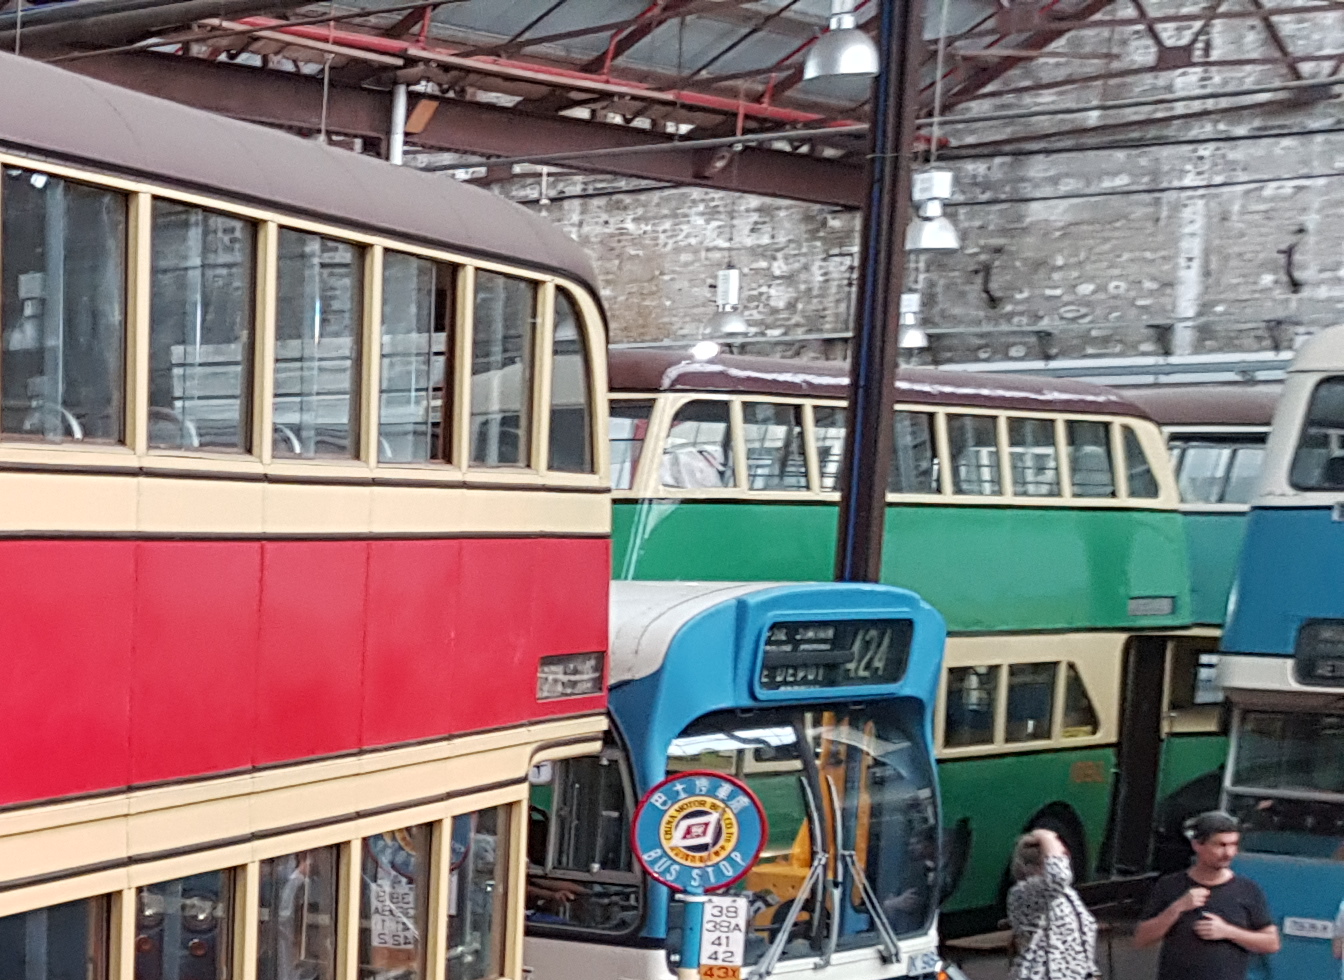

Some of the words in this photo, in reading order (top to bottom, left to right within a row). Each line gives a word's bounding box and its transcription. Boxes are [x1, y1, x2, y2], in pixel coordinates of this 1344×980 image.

[845, 629, 893, 678] 424
[642, 848, 681, 880] BUS
[691, 852, 746, 886] STOP
[711, 905, 738, 919] 38
[705, 920, 742, 933] 38A
[711, 936, 730, 947] 41
[707, 951, 734, 963] 42
